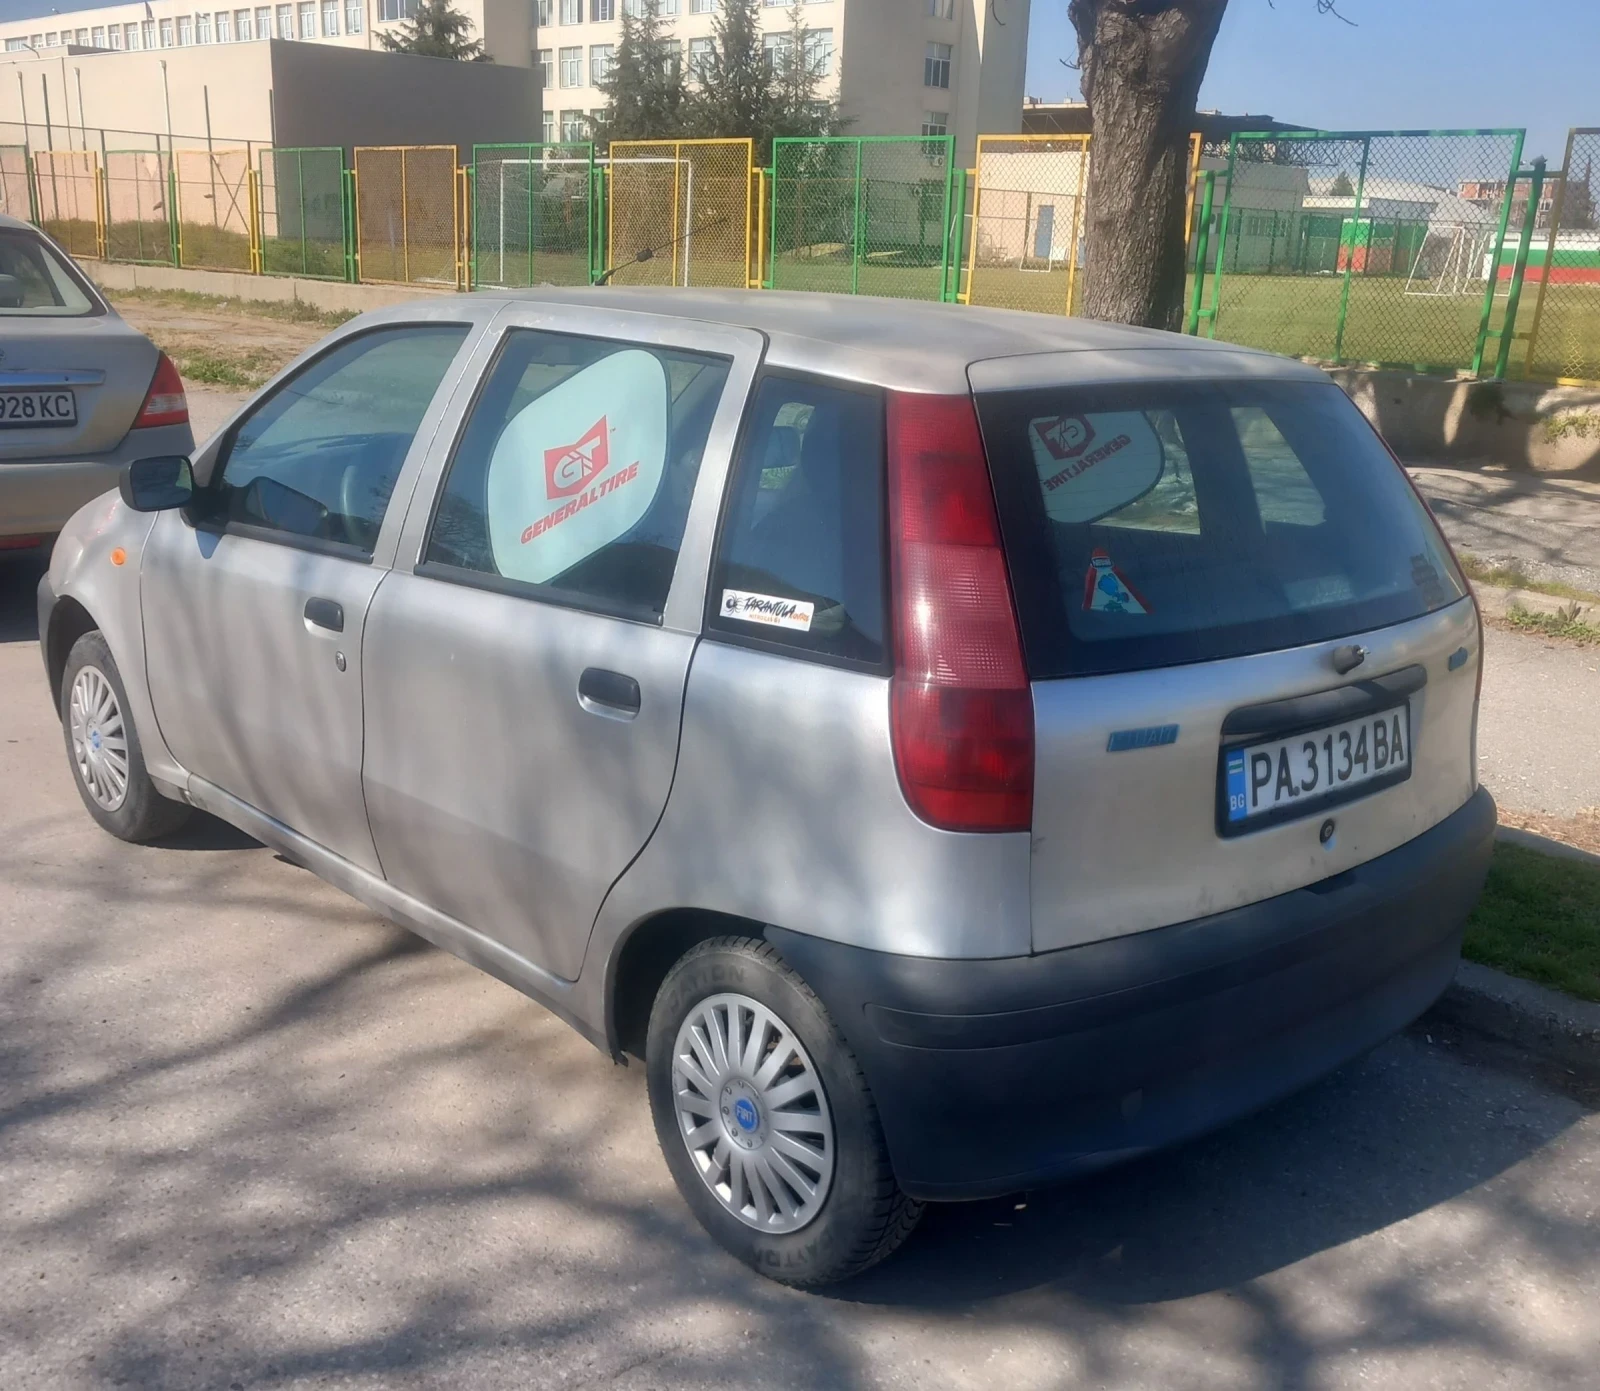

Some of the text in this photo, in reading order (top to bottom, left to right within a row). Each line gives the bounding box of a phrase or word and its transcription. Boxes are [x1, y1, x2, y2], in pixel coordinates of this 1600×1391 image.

[39, 395, 70, 417] KC
[744, 597, 796, 619] TARANTULA
[1230, 793, 1245, 811] BG
